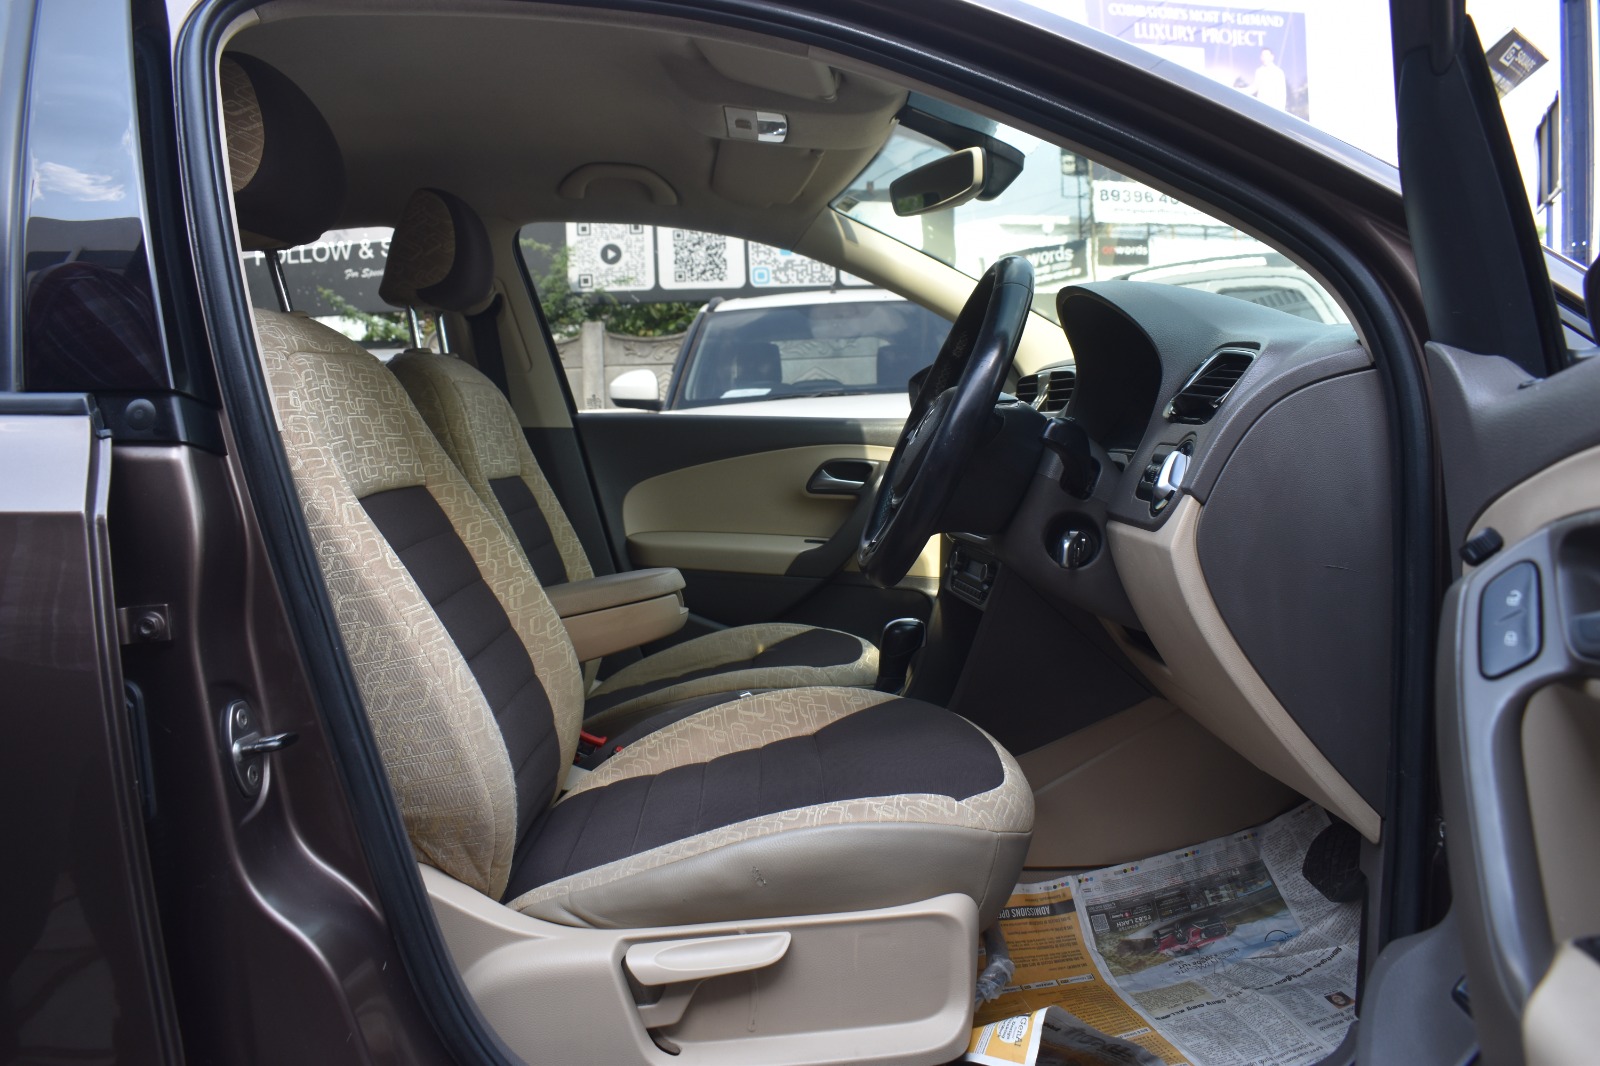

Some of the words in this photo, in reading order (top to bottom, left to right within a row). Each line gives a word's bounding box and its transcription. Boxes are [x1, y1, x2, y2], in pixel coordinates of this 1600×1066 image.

[1134, 22, 1197, 43] LUXURY
[1202, 28, 1267, 47] PROJECT
[1011, 905, 1050, 918] ADMISSIONS
